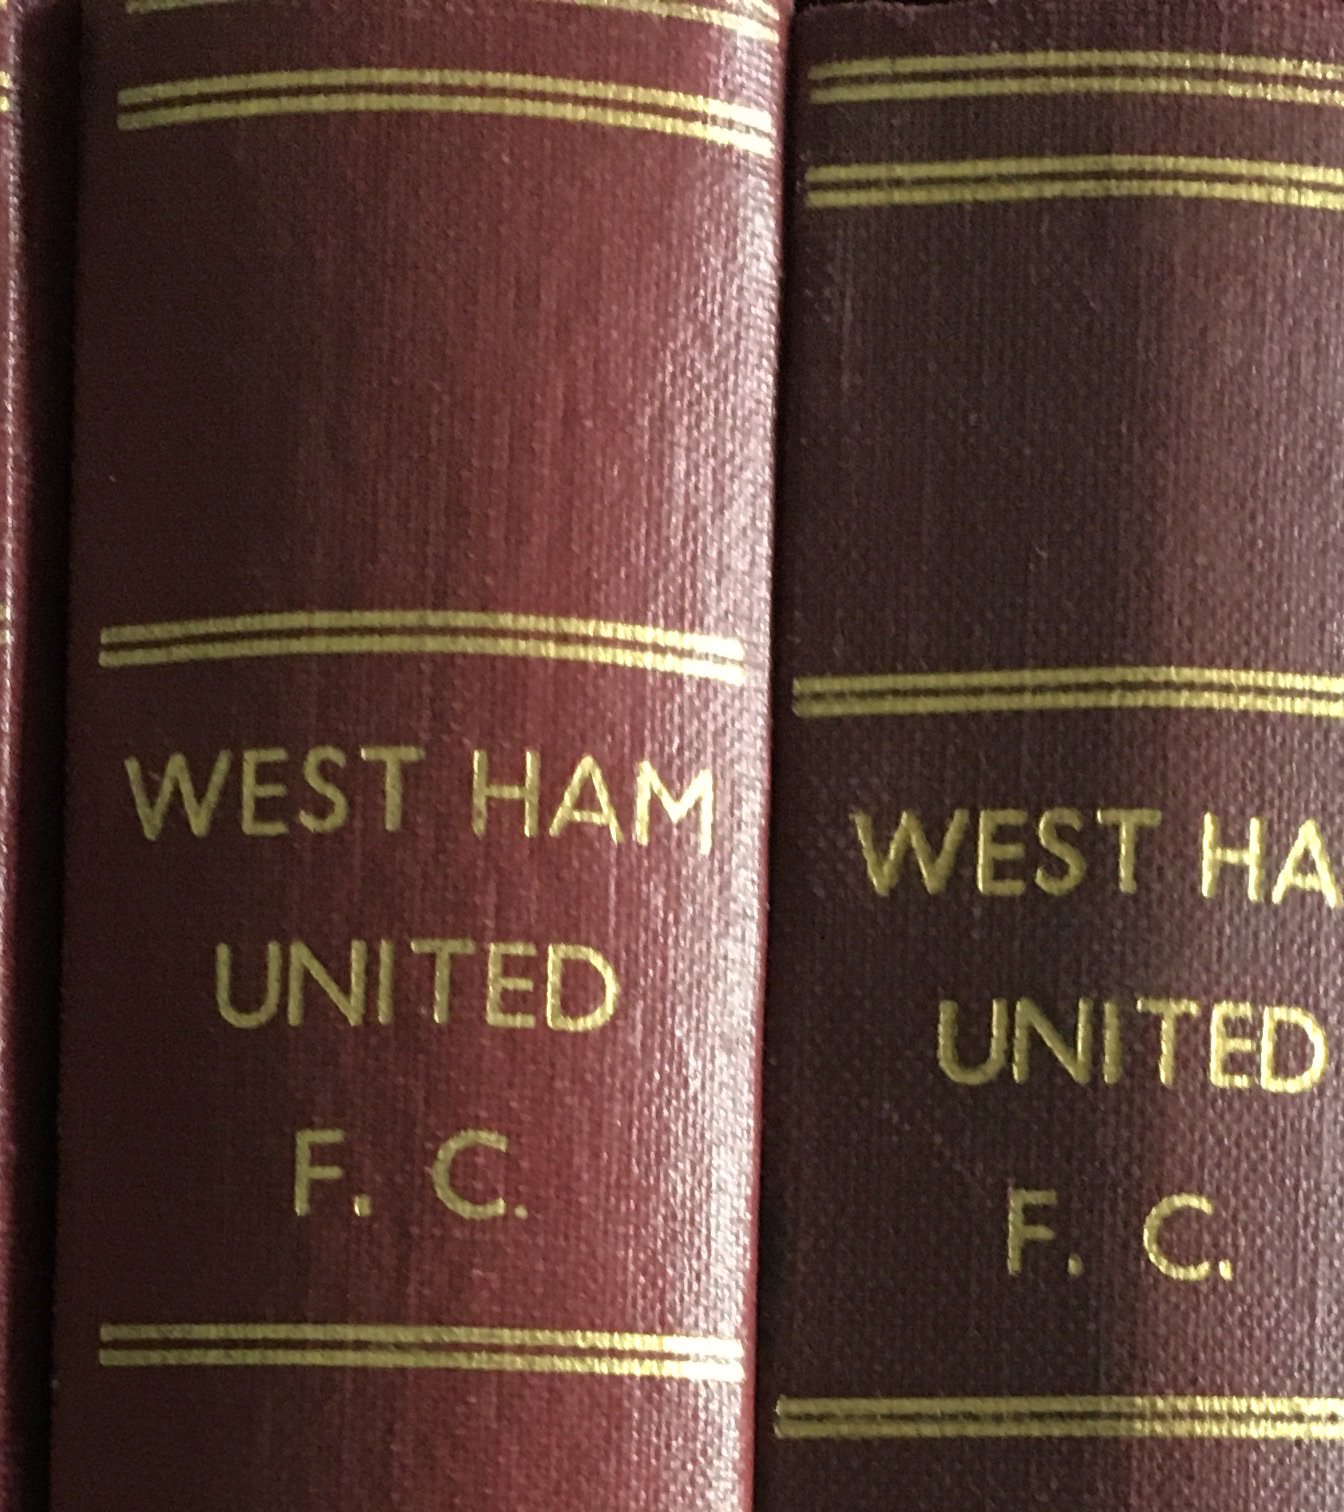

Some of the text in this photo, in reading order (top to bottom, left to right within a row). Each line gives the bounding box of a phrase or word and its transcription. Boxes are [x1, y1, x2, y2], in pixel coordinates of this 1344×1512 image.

[126, 745, 714, 856] WEST HAM
[852, 808, 1161, 895] WEST
[217, 938, 620, 1033] UNITED
[938, 997, 1330, 1094] UNITED
[293, 1128, 527, 1220] F. C.
[1006, 1188, 1234, 1282] F. C.
